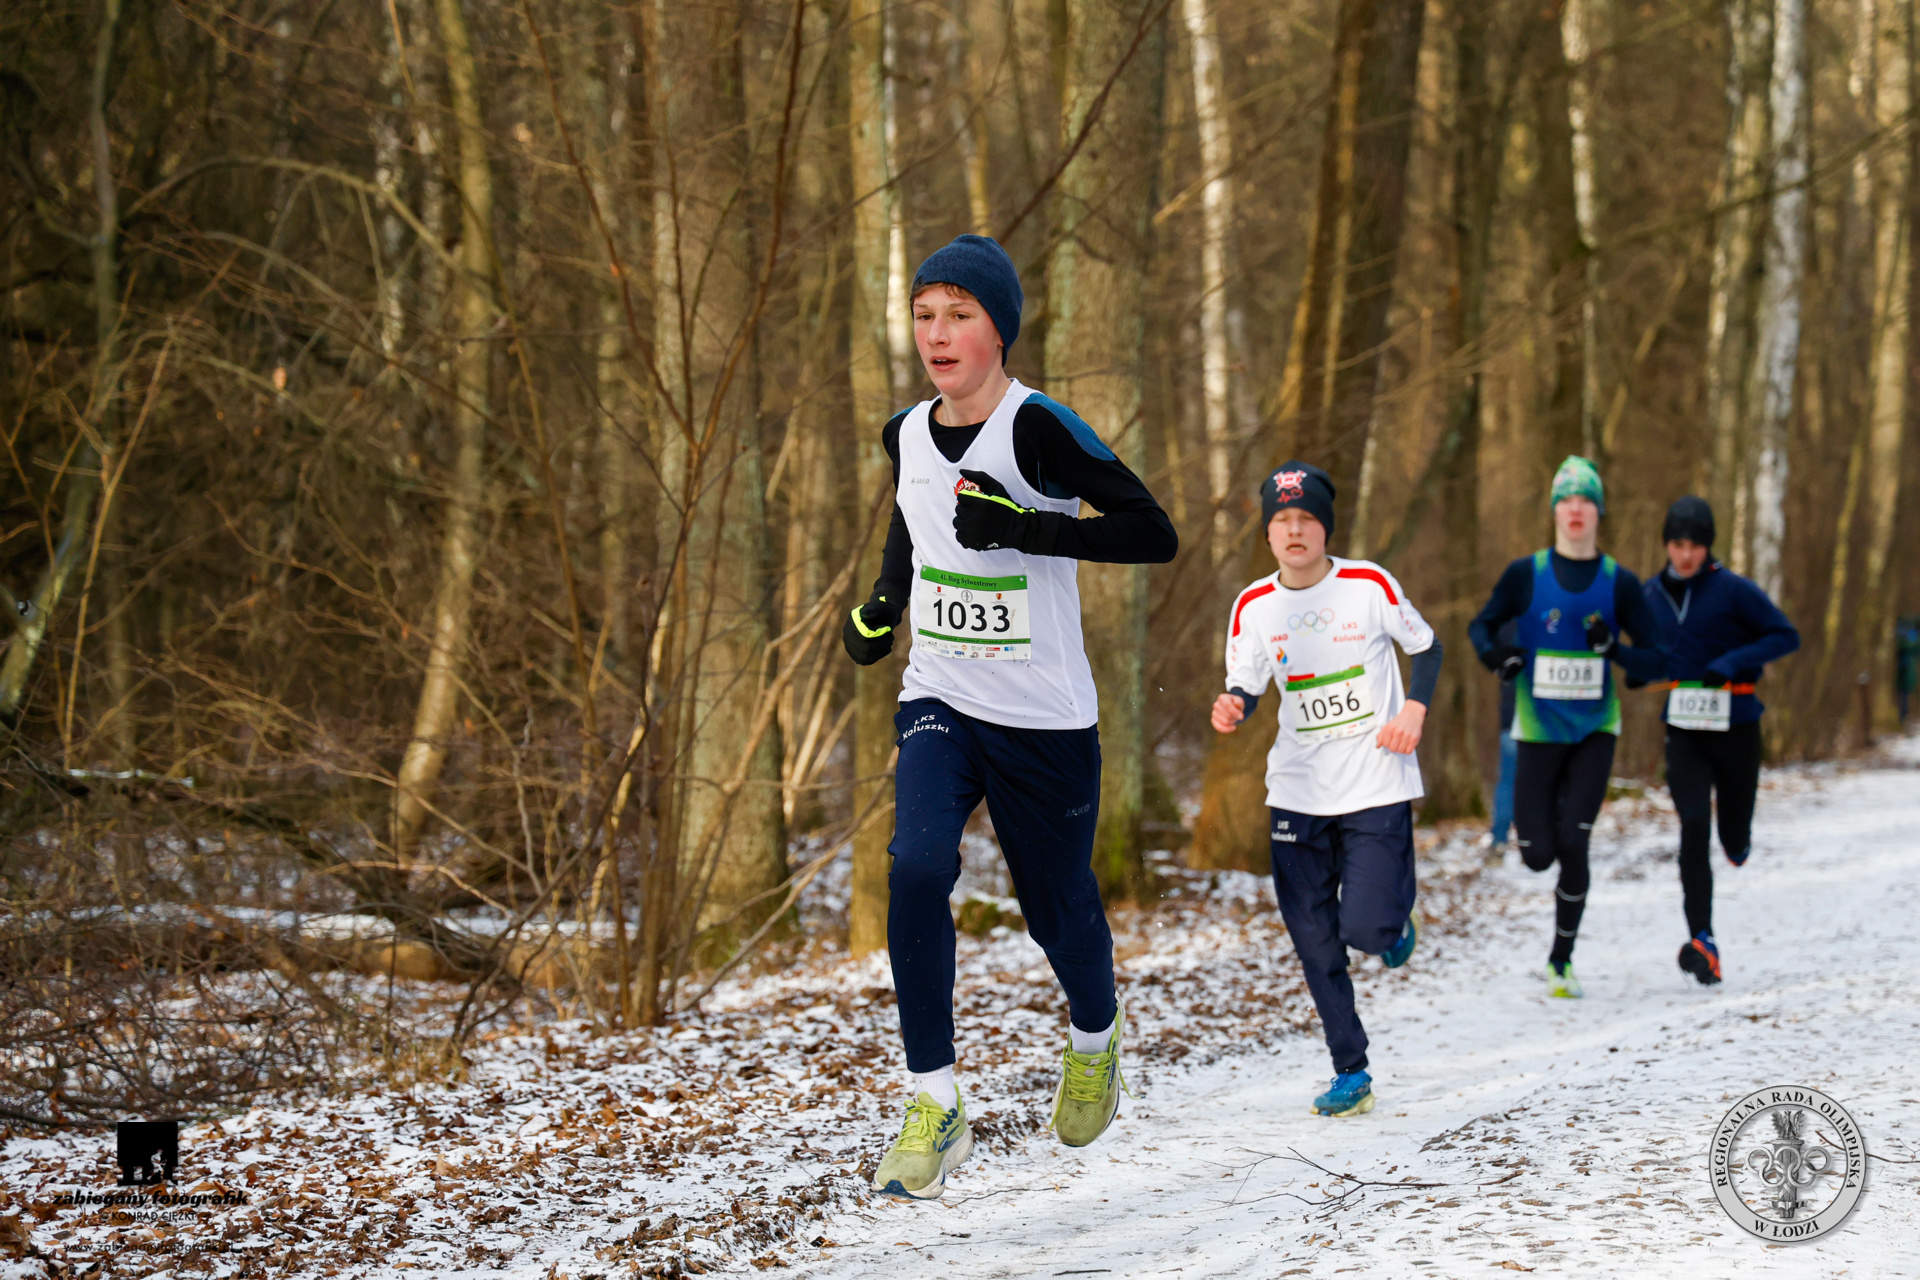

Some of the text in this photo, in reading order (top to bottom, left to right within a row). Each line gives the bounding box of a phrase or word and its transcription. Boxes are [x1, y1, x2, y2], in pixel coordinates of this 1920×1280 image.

[933, 598, 1010, 633] 1033
[1547, 665, 1593, 681] 1038
[1299, 690, 1360, 722] 1056
[1678, 694, 1720, 713] 1028
[902, 723, 949, 741] Koluszki
